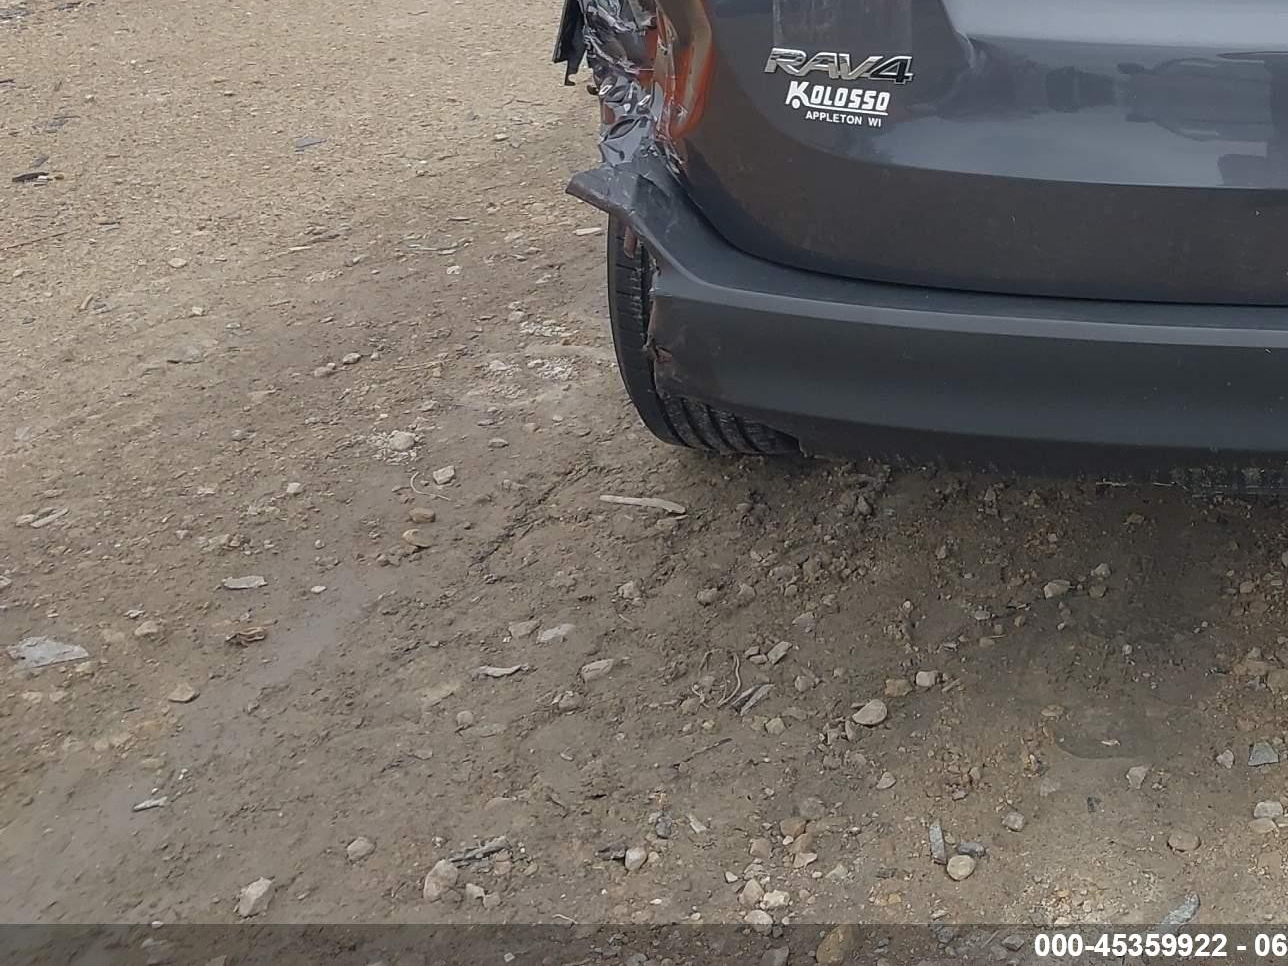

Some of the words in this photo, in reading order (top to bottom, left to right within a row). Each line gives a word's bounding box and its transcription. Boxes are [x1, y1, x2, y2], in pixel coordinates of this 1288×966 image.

[764, 48, 914, 84] RAV4
[785, 81, 891, 111] KOLOSSO
[805, 111, 863, 125] APPLETON
[867, 117, 882, 128] WI
